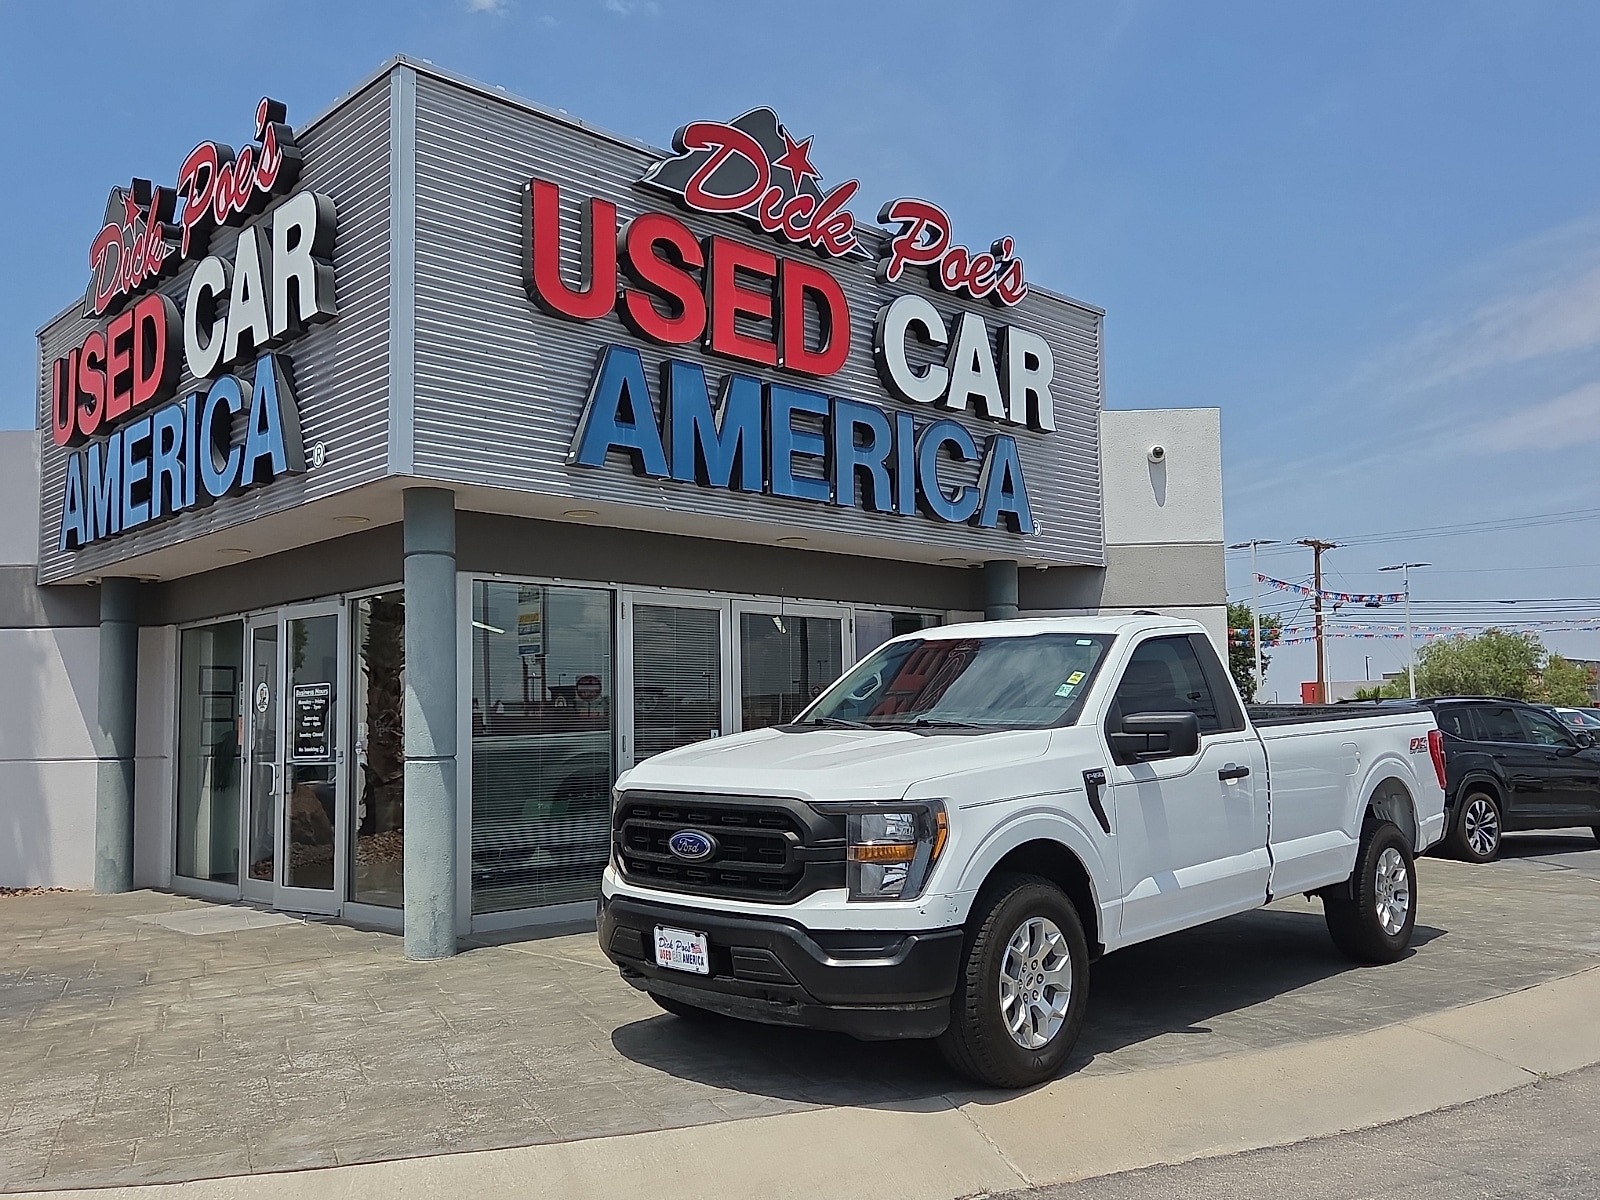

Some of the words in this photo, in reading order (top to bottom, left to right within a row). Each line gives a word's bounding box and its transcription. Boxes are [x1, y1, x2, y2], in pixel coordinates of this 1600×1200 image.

[90, 188, 172, 314] Dick
[177, 97, 286, 258] Poe's
[682, 119, 861, 257] Dick
[884, 197, 1029, 306] Poe's
[52, 294, 167, 446] USED
[184, 191, 320, 379] CAR
[530, 177, 852, 376] USED
[882, 294, 1057, 432] CAR
[59, 352, 287, 551] AMERICA
[574, 343, 1034, 535] AMERICA
[677, 837, 700, 853] Ford
[682, 953, 705, 967] AMERICA
